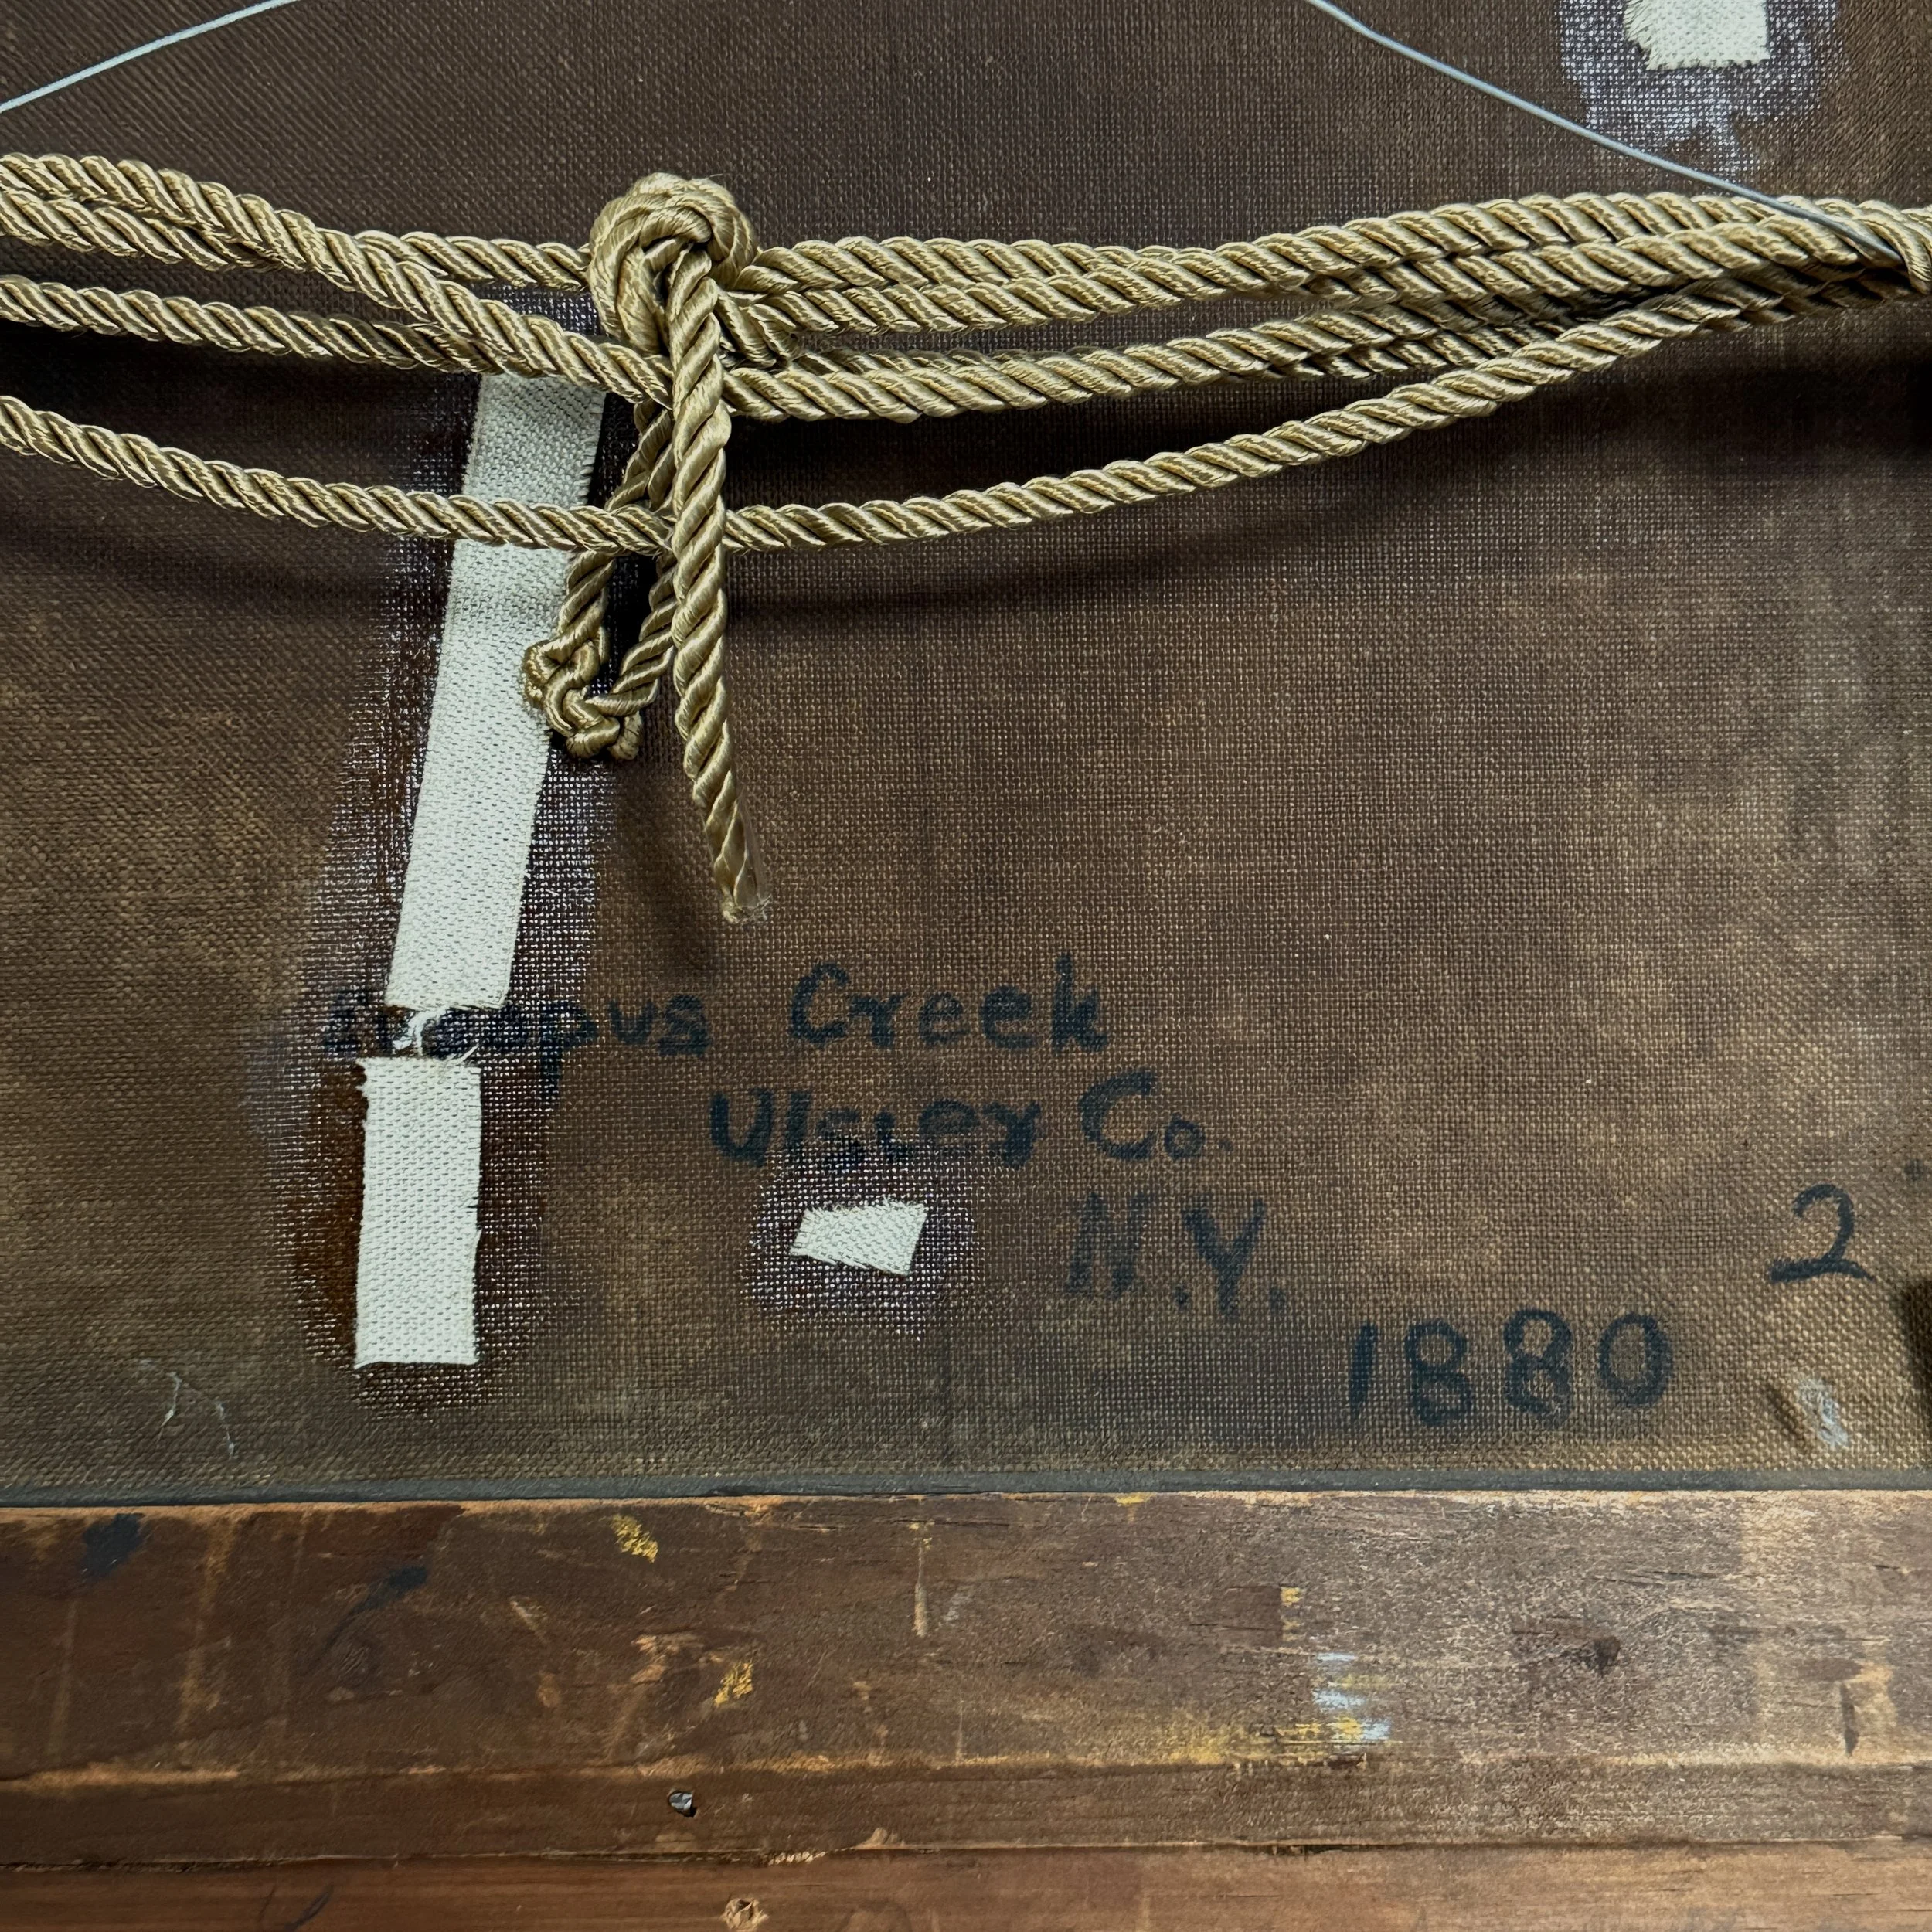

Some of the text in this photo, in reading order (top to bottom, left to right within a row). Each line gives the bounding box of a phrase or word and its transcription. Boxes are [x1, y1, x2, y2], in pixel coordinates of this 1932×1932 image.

[787, 951, 1107, 1053] Creek
[1081, 1067, 1234, 1160] Co.
[1065, 1191, 1286, 1313] N.Y.
[1767, 1182, 1877, 1284] 2
[1348, 1308, 1674, 1429] 1880
